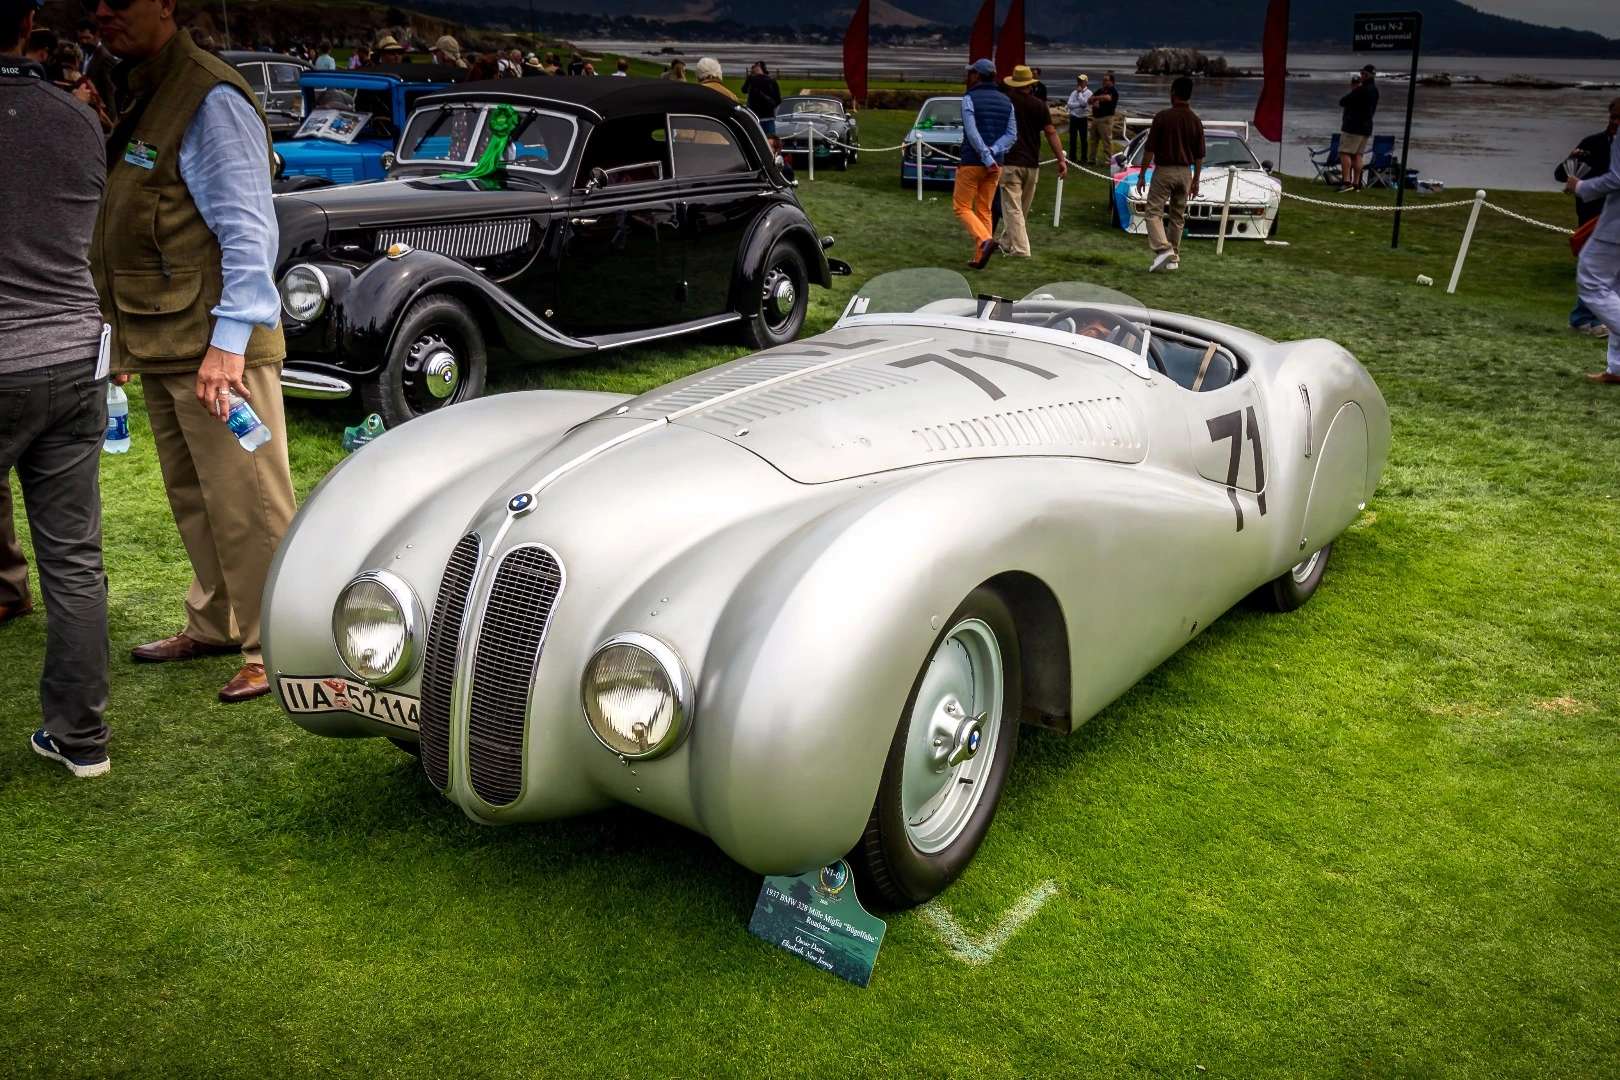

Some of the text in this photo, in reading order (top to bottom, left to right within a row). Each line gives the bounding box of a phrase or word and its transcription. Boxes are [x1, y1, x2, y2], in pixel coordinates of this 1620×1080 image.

[1365, 22, 1403, 31] Class N-2
[1355, 32, 1412, 41] BMW Centennial
[1, 66, 19, 74] 2016
[886, 348, 1058, 402] 71
[1206, 406, 1267, 532] 71
[766, 887, 780, 899] 1937
[779, 893, 798, 907] BMW
[796, 901, 809, 912] 328
[807, 906, 824, 919] Mille
[823, 913, 843, 928] Miglia
[805, 915, 831, 933] Roadster
[805, 950, 818, 961] New
